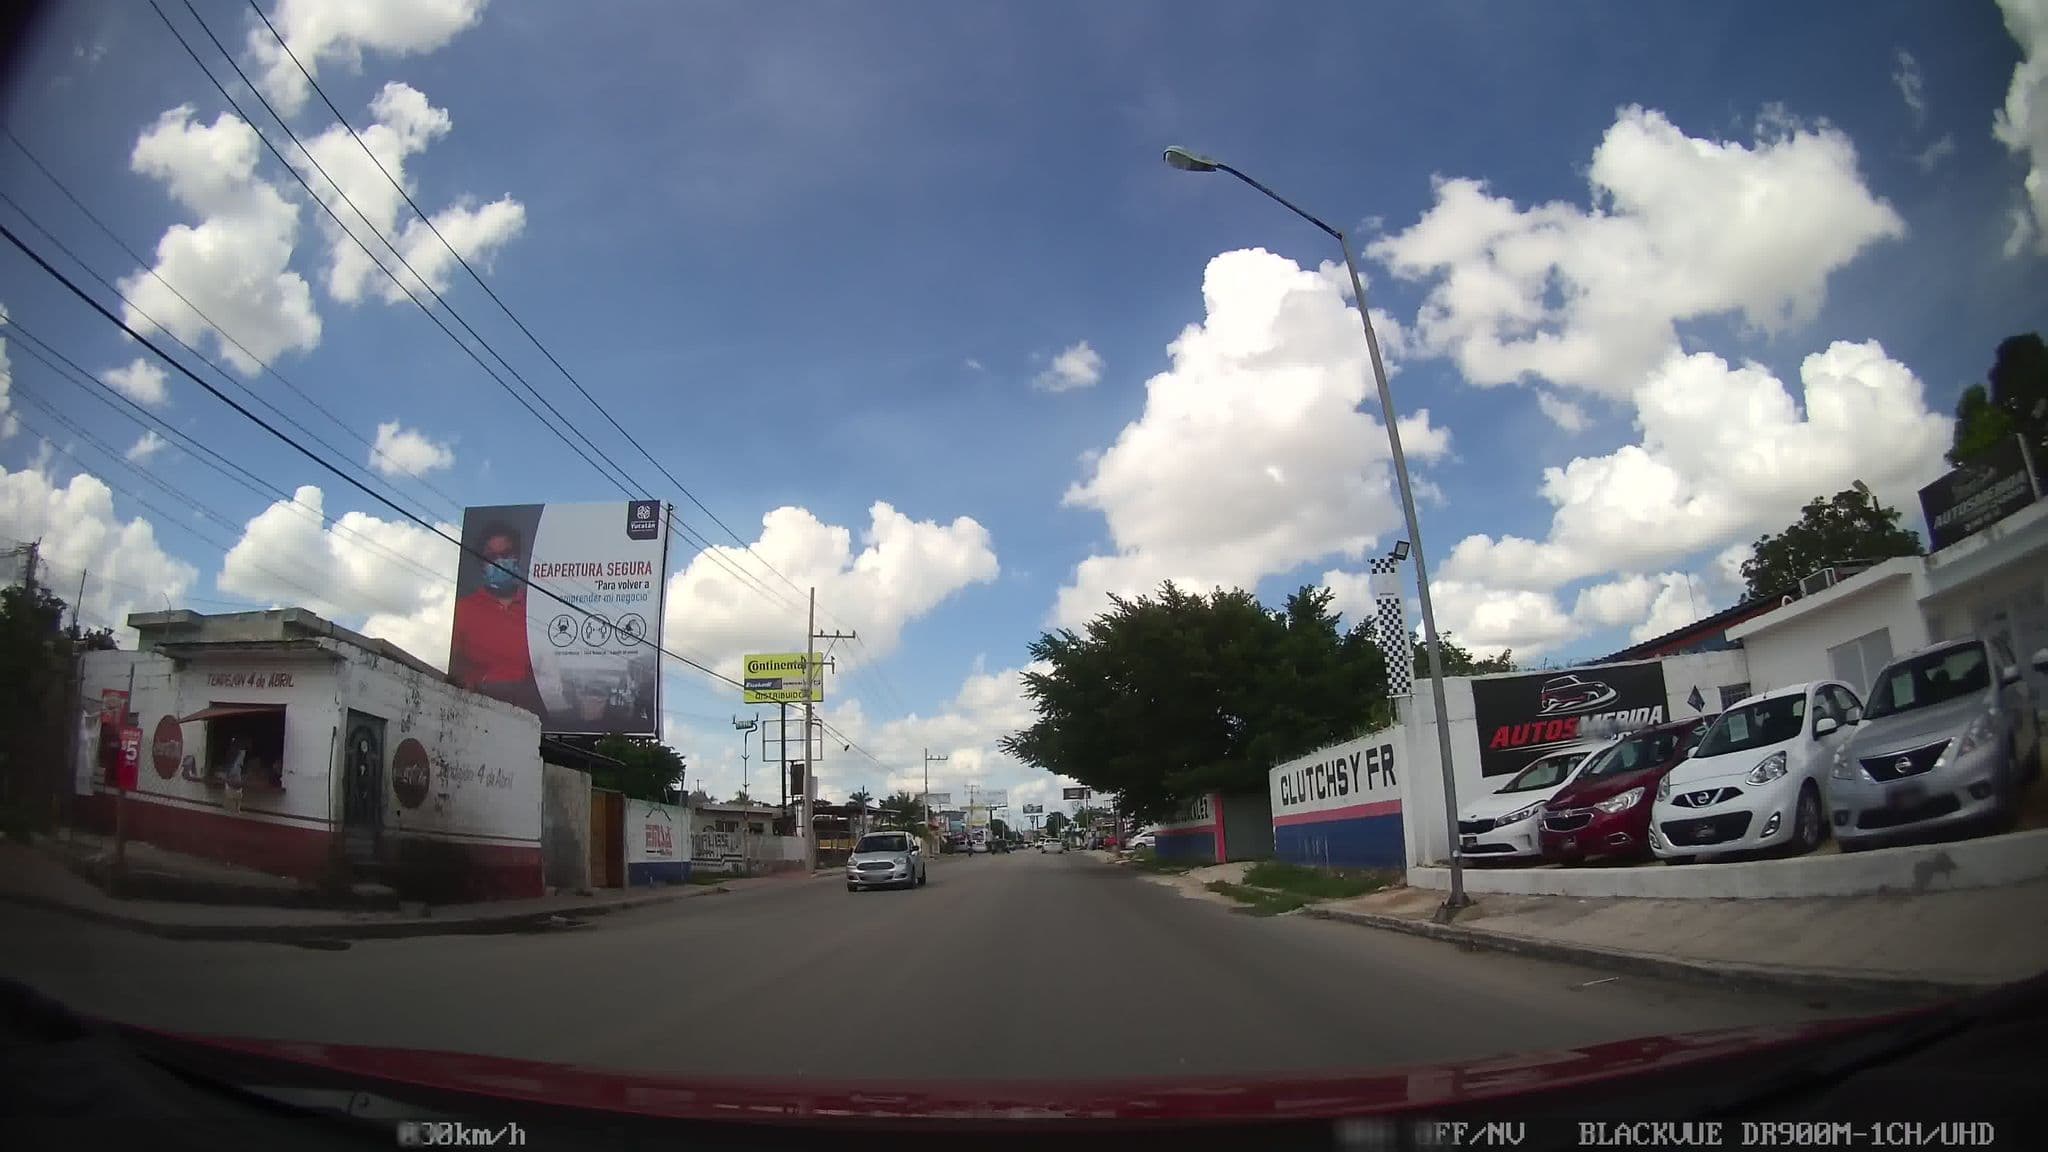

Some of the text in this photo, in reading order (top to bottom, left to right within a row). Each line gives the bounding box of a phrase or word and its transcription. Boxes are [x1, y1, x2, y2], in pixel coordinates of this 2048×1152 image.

[533, 561, 652, 578] REAPERTURA SEGURA
[618, 580, 642, 590] volver
[560, 592, 601, 604] emprender
[603, 593, 614, 601] mi
[247, 672, 256, 687] 4
[256, 675, 266, 689] de
[268, 672, 295, 687] ABRIL
[478, 763, 486, 784] 4
[1366, 744, 1397, 790] FR
